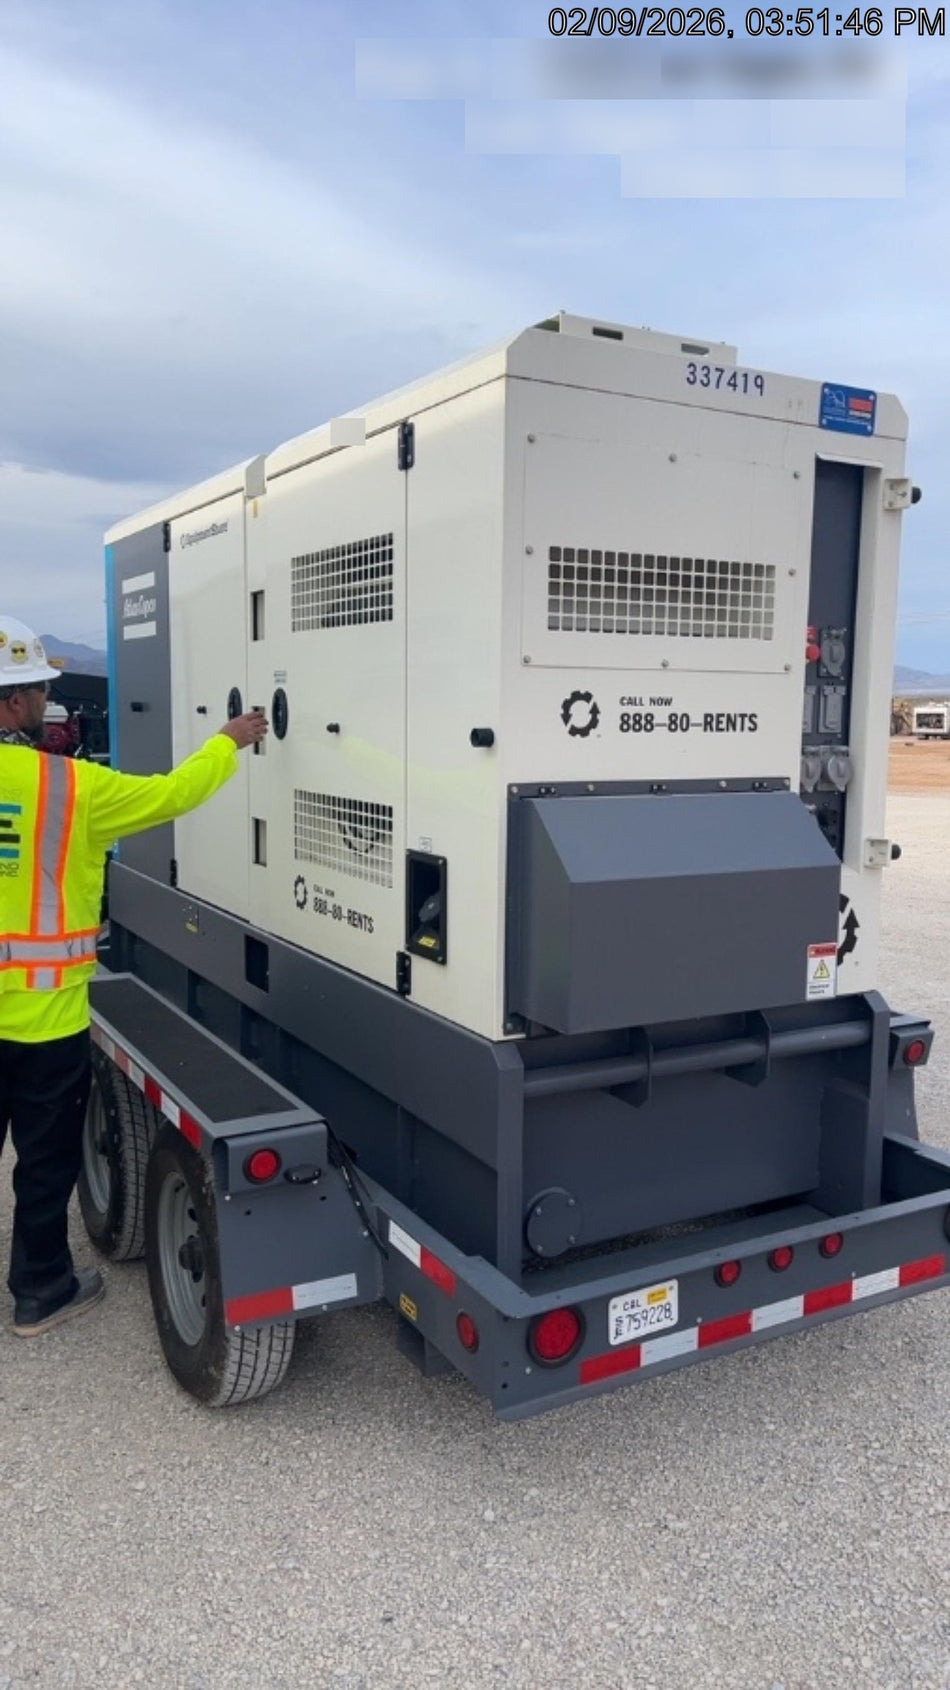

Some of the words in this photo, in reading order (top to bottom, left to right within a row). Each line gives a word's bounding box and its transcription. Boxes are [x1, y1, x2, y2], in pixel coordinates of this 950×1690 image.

[686, 363, 765, 396] 337419
[619, 697, 645, 707] CALL
[649, 697, 673, 707] NOW
[619, 713, 758, 733] 888-80-RENTS
[313, 896, 374, 934] 888-80-RENTS
[625, 1302, 673, 1332] 759228
